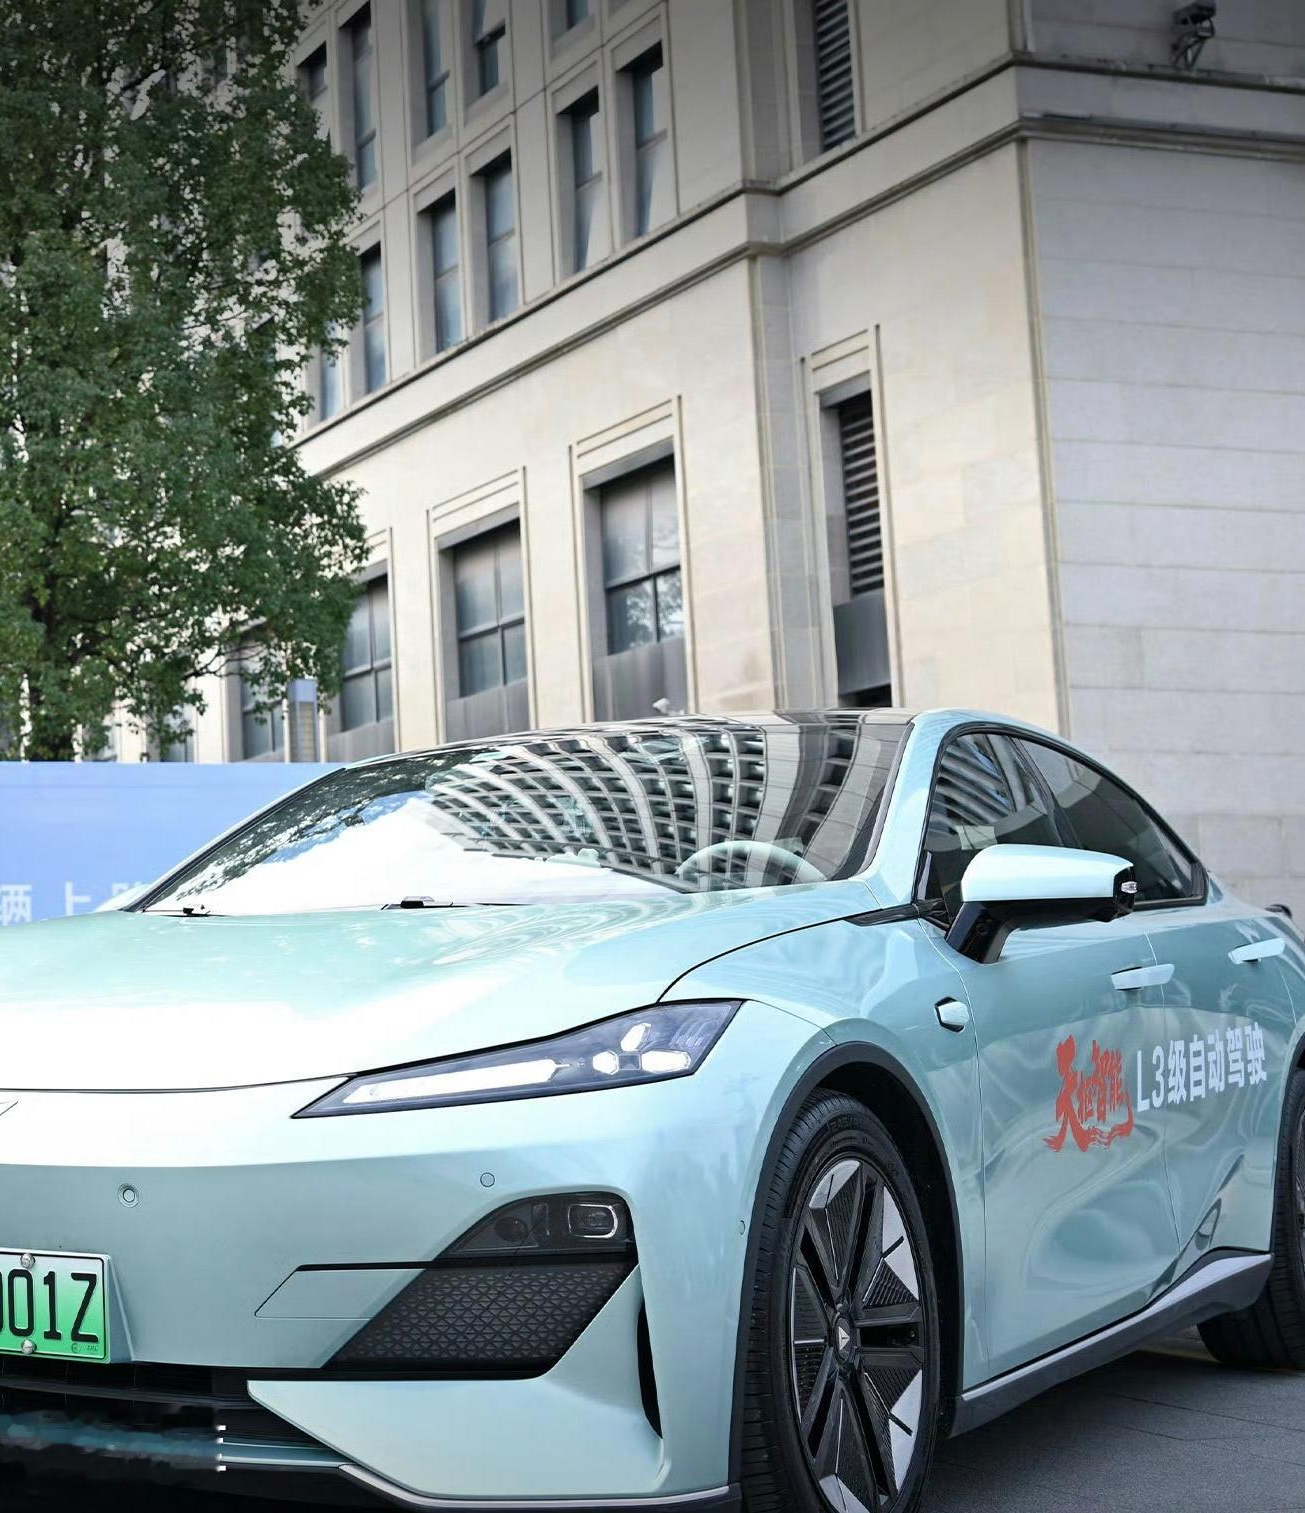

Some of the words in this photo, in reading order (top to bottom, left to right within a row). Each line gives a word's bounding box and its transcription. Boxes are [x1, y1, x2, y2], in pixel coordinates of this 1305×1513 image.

[1136, 1021, 1268, 1113] L3级自动驾驶
